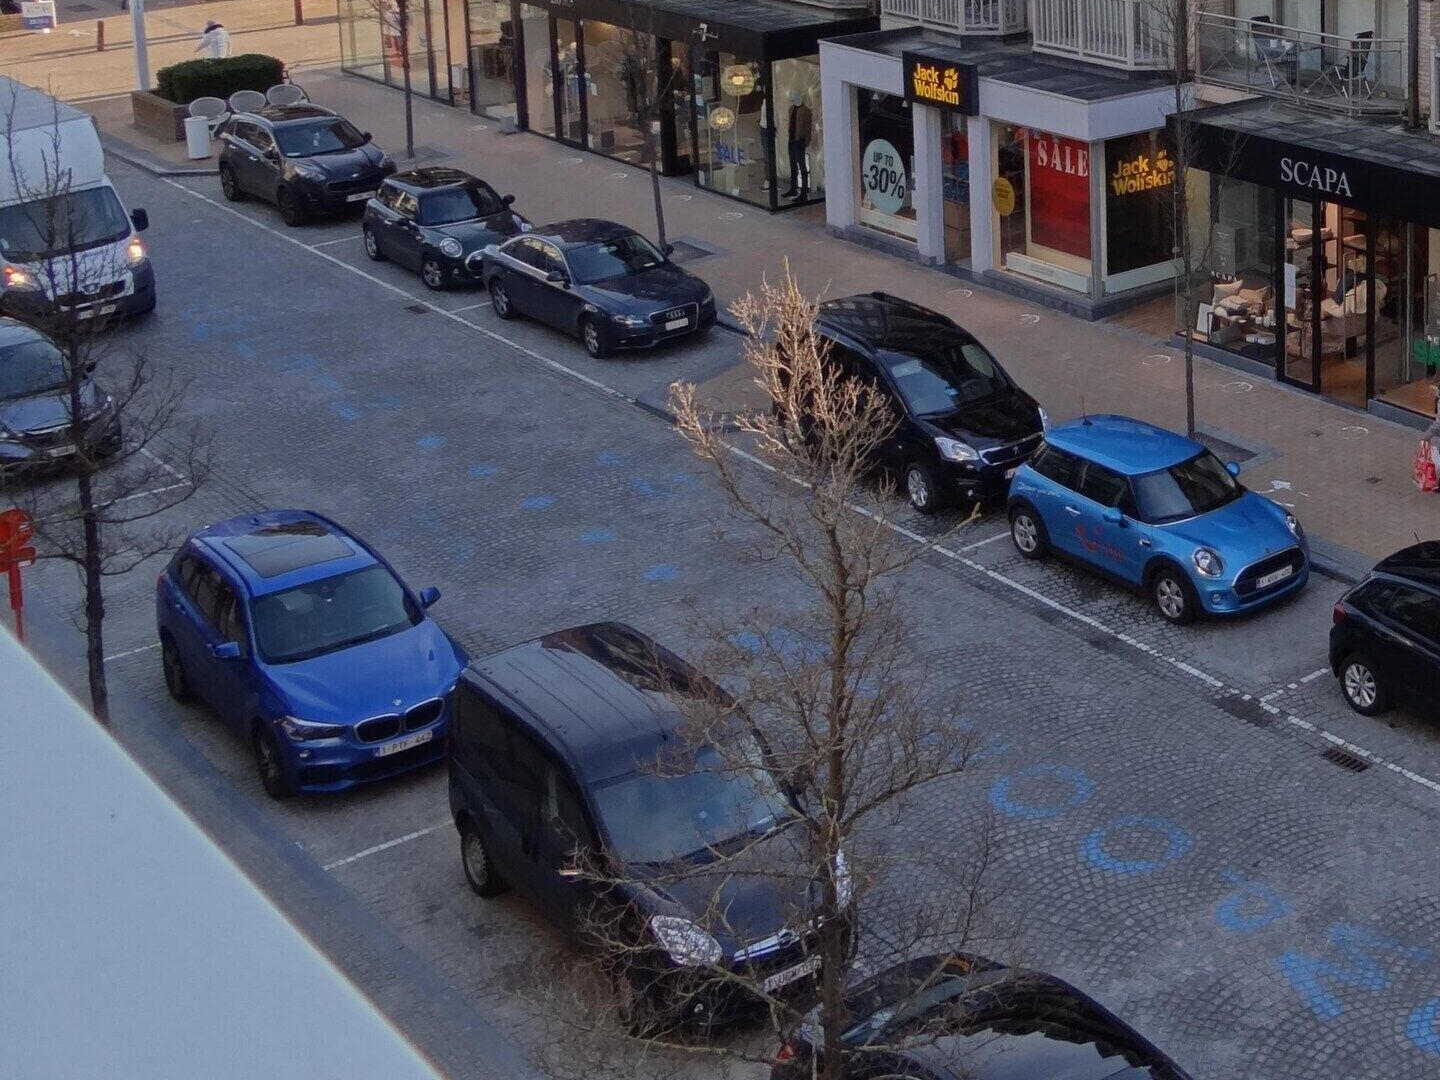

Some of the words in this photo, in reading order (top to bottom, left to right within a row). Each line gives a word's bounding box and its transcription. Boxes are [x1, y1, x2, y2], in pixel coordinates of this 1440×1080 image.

[914, 63, 939, 83] Jack
[914, 79, 959, 105] Wolfskin
[873, 151, 883, 163] UP
[885, 154, 894, 167] TO
[1037, 139, 1088, 178] SALE
[1113, 155, 1149, 178] Jack
[864, 164, 905, 199] -30%
[1111, 171, 1175, 196] Wolfskin
[1280, 157, 1353, 197] SCAPA
[1211, 270, 1237, 282] SCAPA
